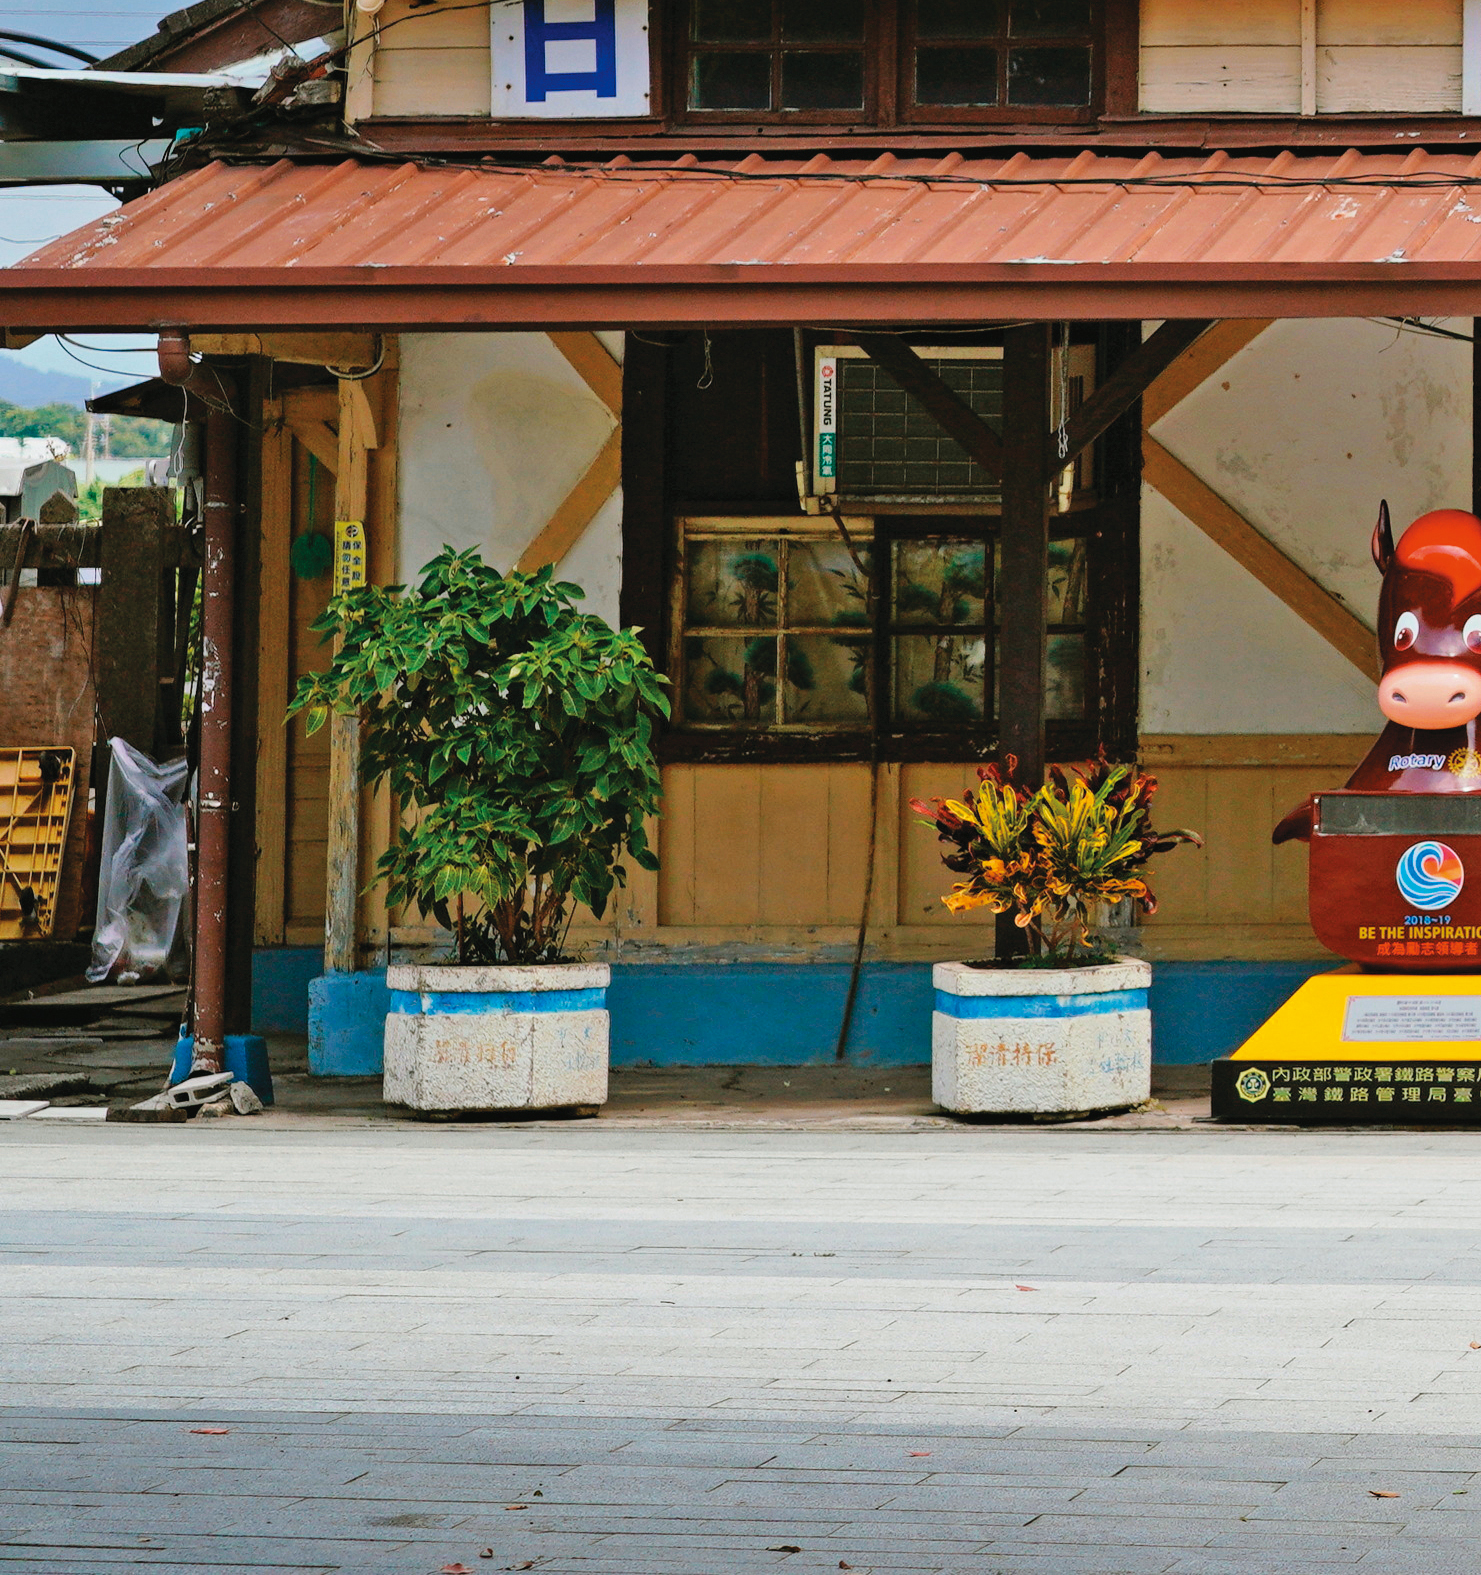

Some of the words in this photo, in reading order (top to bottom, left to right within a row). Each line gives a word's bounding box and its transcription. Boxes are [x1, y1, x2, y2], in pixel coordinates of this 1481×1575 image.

[823, 378, 832, 426] TATUNG
[1388, 754, 1446, 771] Rotary
[1359, 926, 1376, 939] BE
[1380, 926, 1405, 939] THE
